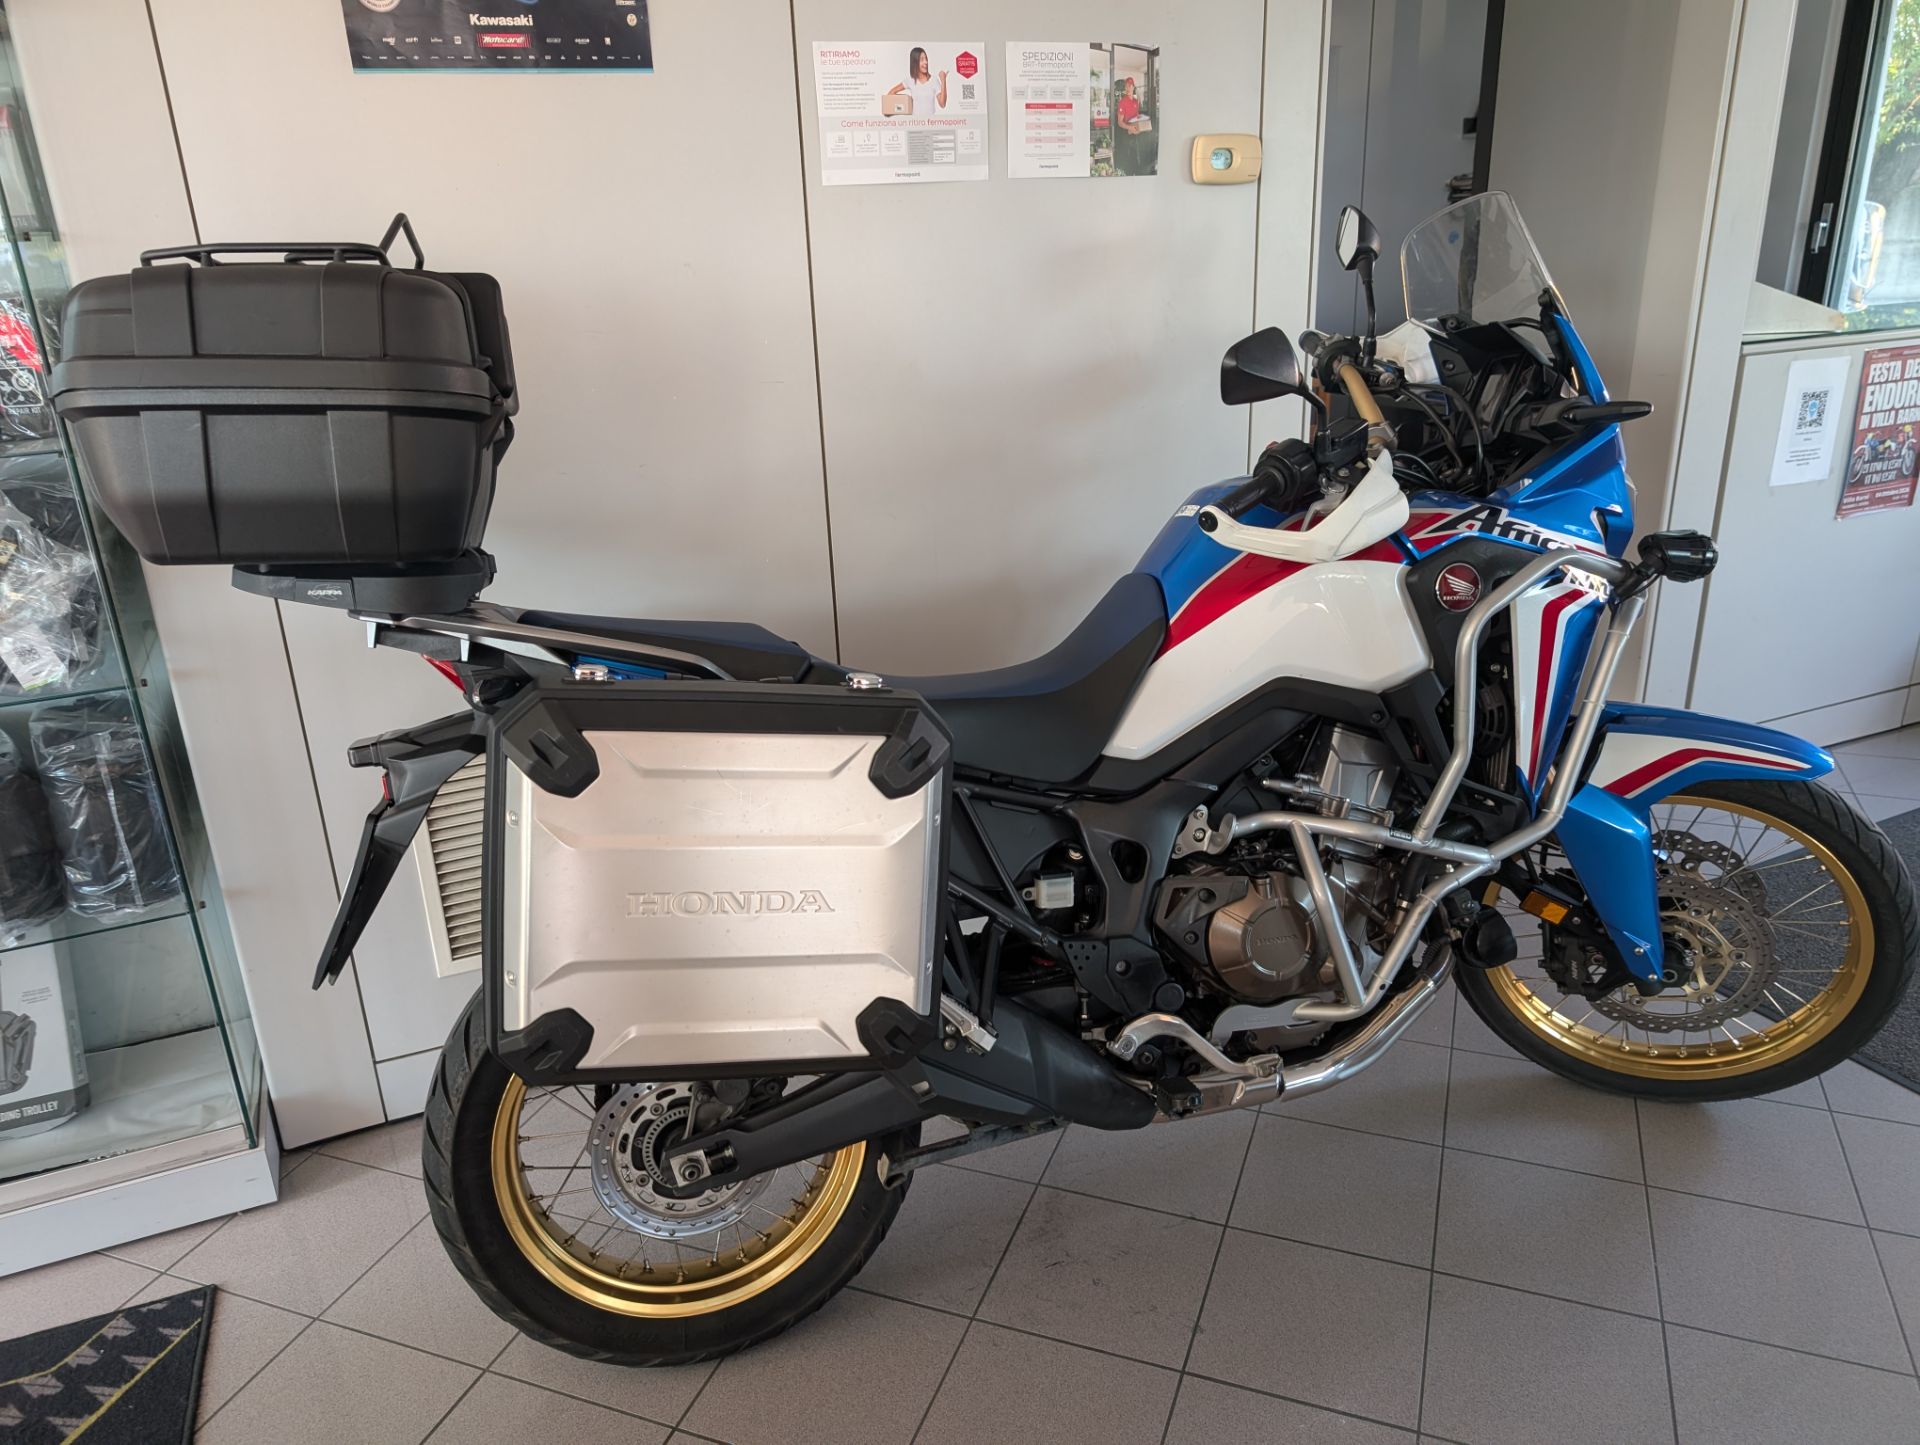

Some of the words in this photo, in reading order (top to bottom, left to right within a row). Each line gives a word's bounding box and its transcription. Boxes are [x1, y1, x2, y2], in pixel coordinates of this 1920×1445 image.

[469, 13, 534, 27] Kawasaki
[482, 35, 526, 45] Motocard
[820, 50, 860, 59] RITIRIAMO
[1022, 51, 1074, 61] SPEDIZIONI
[842, 58, 876, 68] spedizioni
[840, 120, 864, 128] Come
[865, 119, 896, 128] funziona
[897, 119, 907, 127] un
[908, 118, 925, 127] ritiro
[927, 118, 967, 129] fermopoint
[1867, 360, 1902, 384] FESTA
[1871, 410, 1896, 428] VILLA
[1425, 504, 1575, 550] Afric
[308, 589, 342, 597] KAPPA
[625, 889, 836, 918] HONDA
[1254, 933, 1299, 946] HONDA
[21, 1101, 58, 1117] TROLLEY
